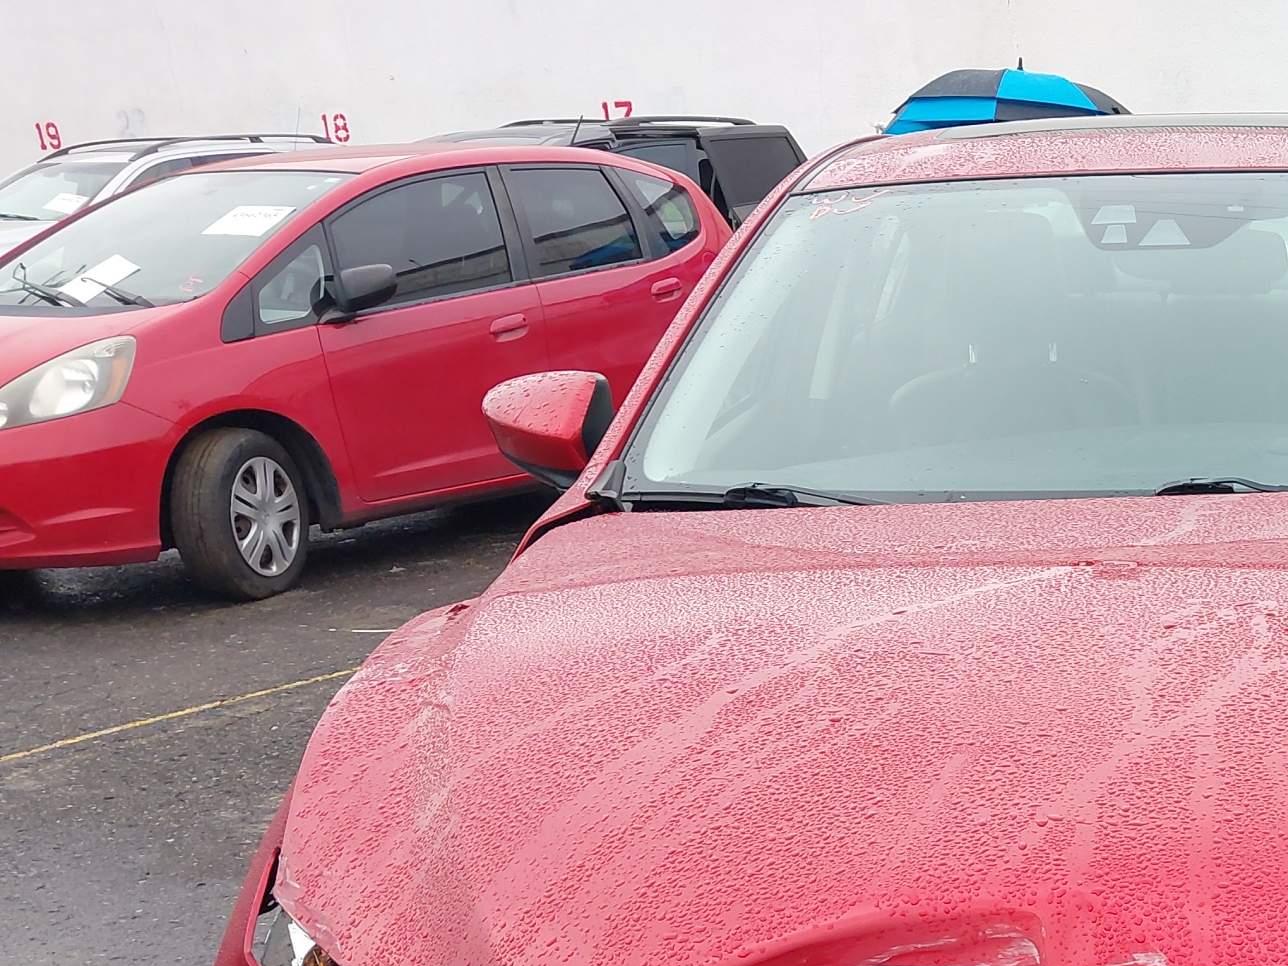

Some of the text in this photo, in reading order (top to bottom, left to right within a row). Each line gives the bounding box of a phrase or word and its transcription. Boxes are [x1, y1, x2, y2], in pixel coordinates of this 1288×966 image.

[601, 101, 632, 121] 17
[35, 122, 62, 150] 19
[321, 113, 350, 143] 18
